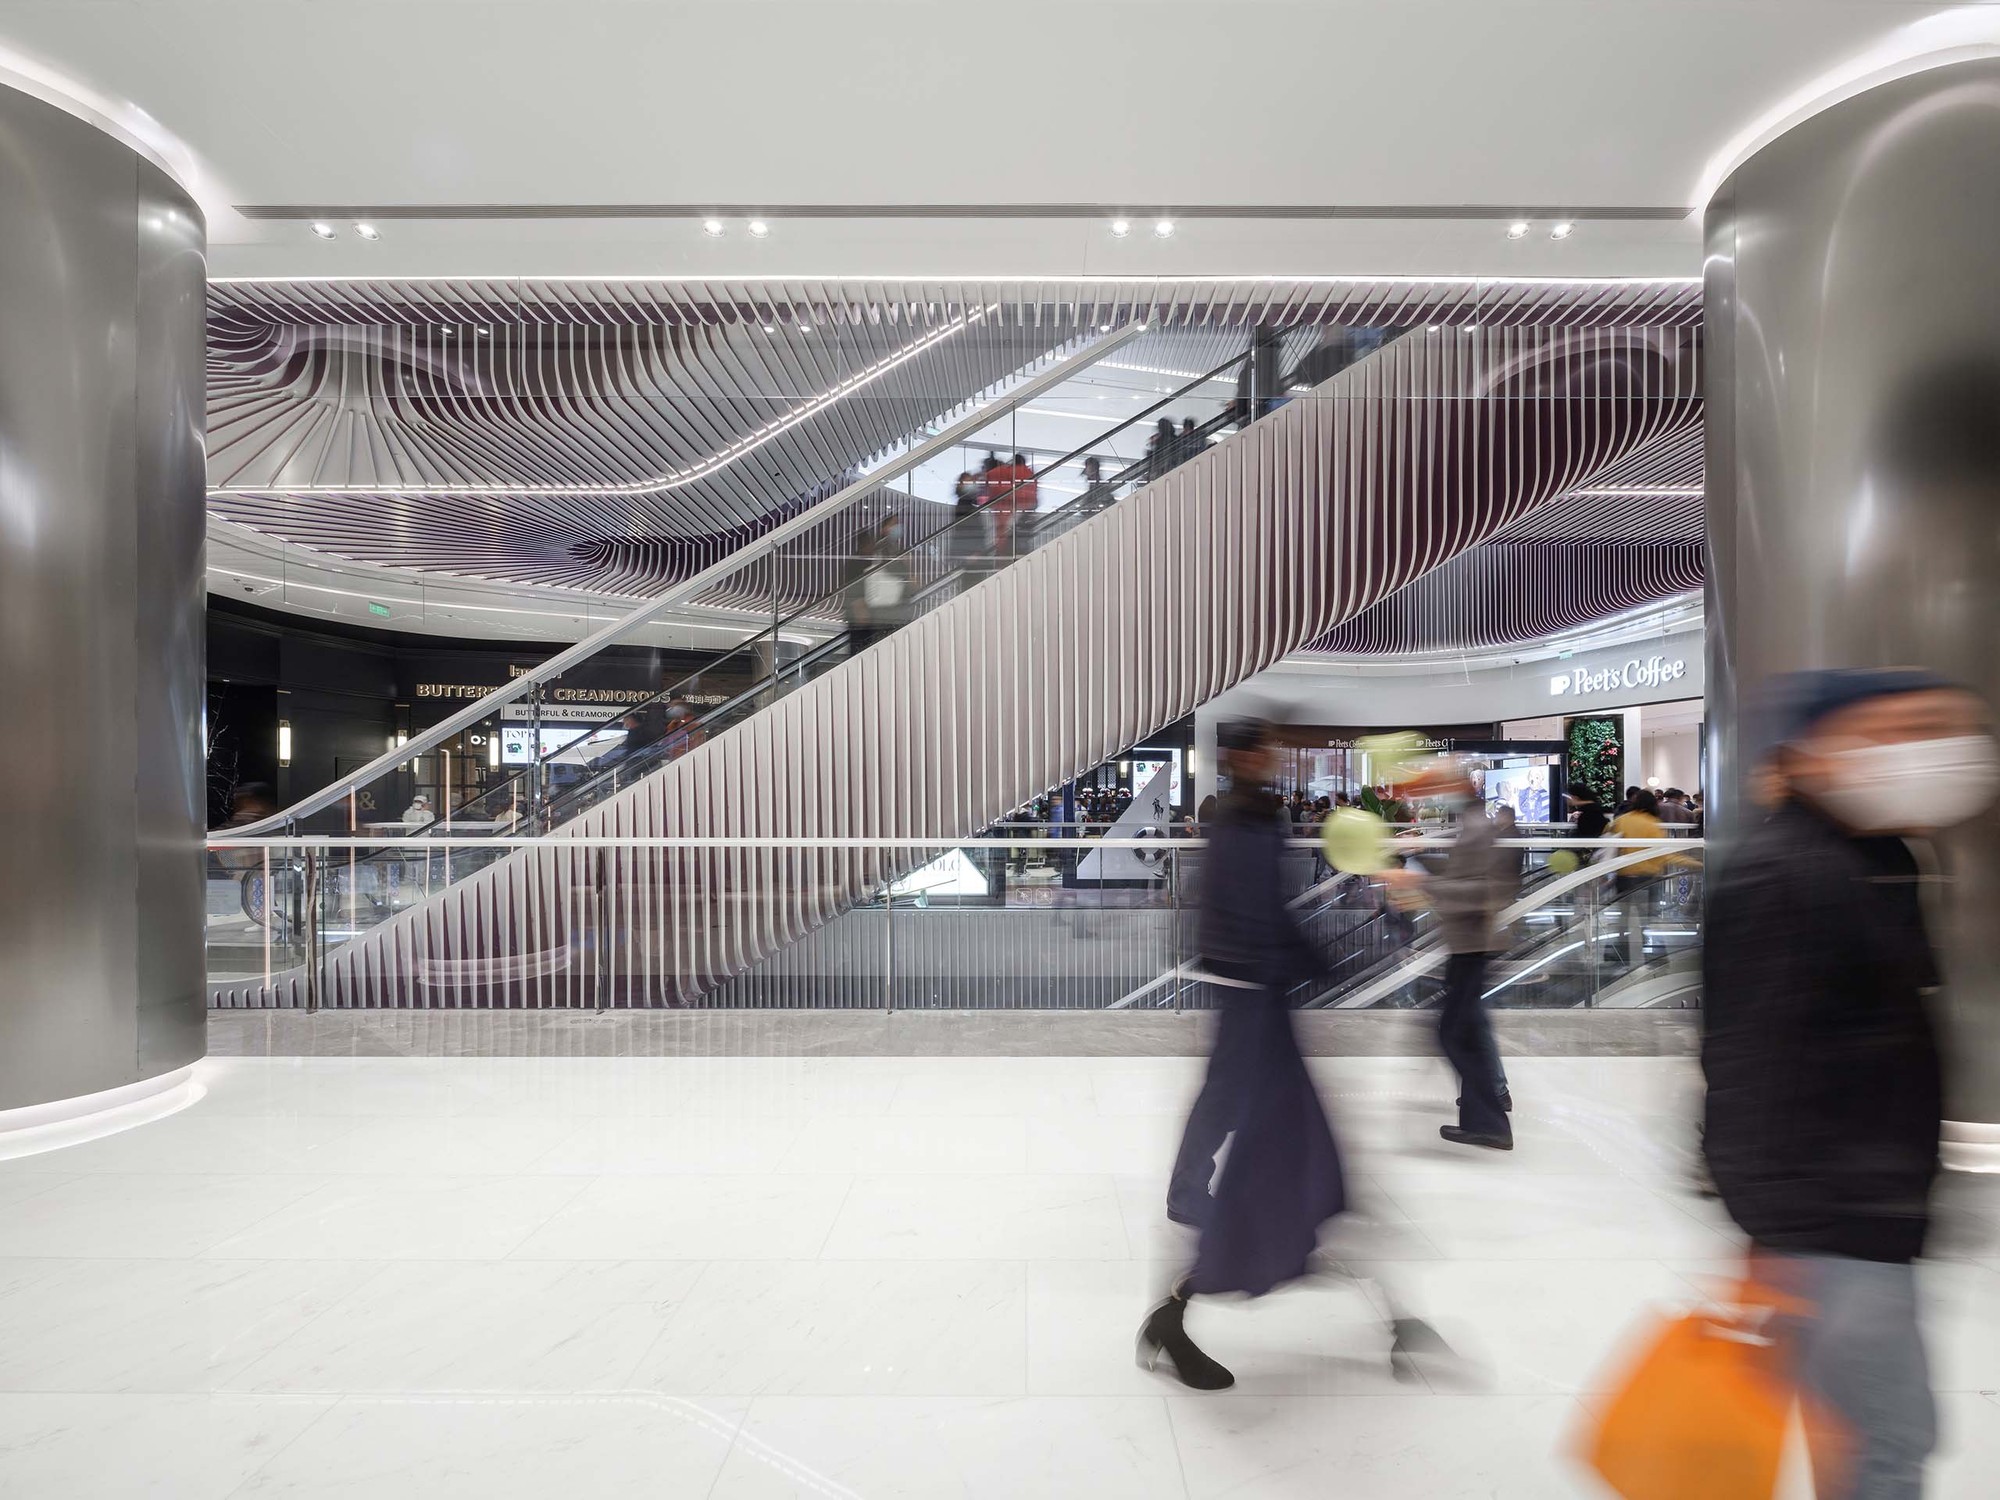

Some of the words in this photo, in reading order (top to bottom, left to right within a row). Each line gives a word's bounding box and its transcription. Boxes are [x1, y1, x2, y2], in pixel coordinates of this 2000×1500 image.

[1572, 667, 1621, 695] Peet's
[1622, 655, 1685, 688] Coffee
[514, 709, 560, 717] BUTTRFUL
[561, 708, 569, 717] &
[570, 710, 621, 719] CREAMOROU
[505, 730, 528, 739] TOP
